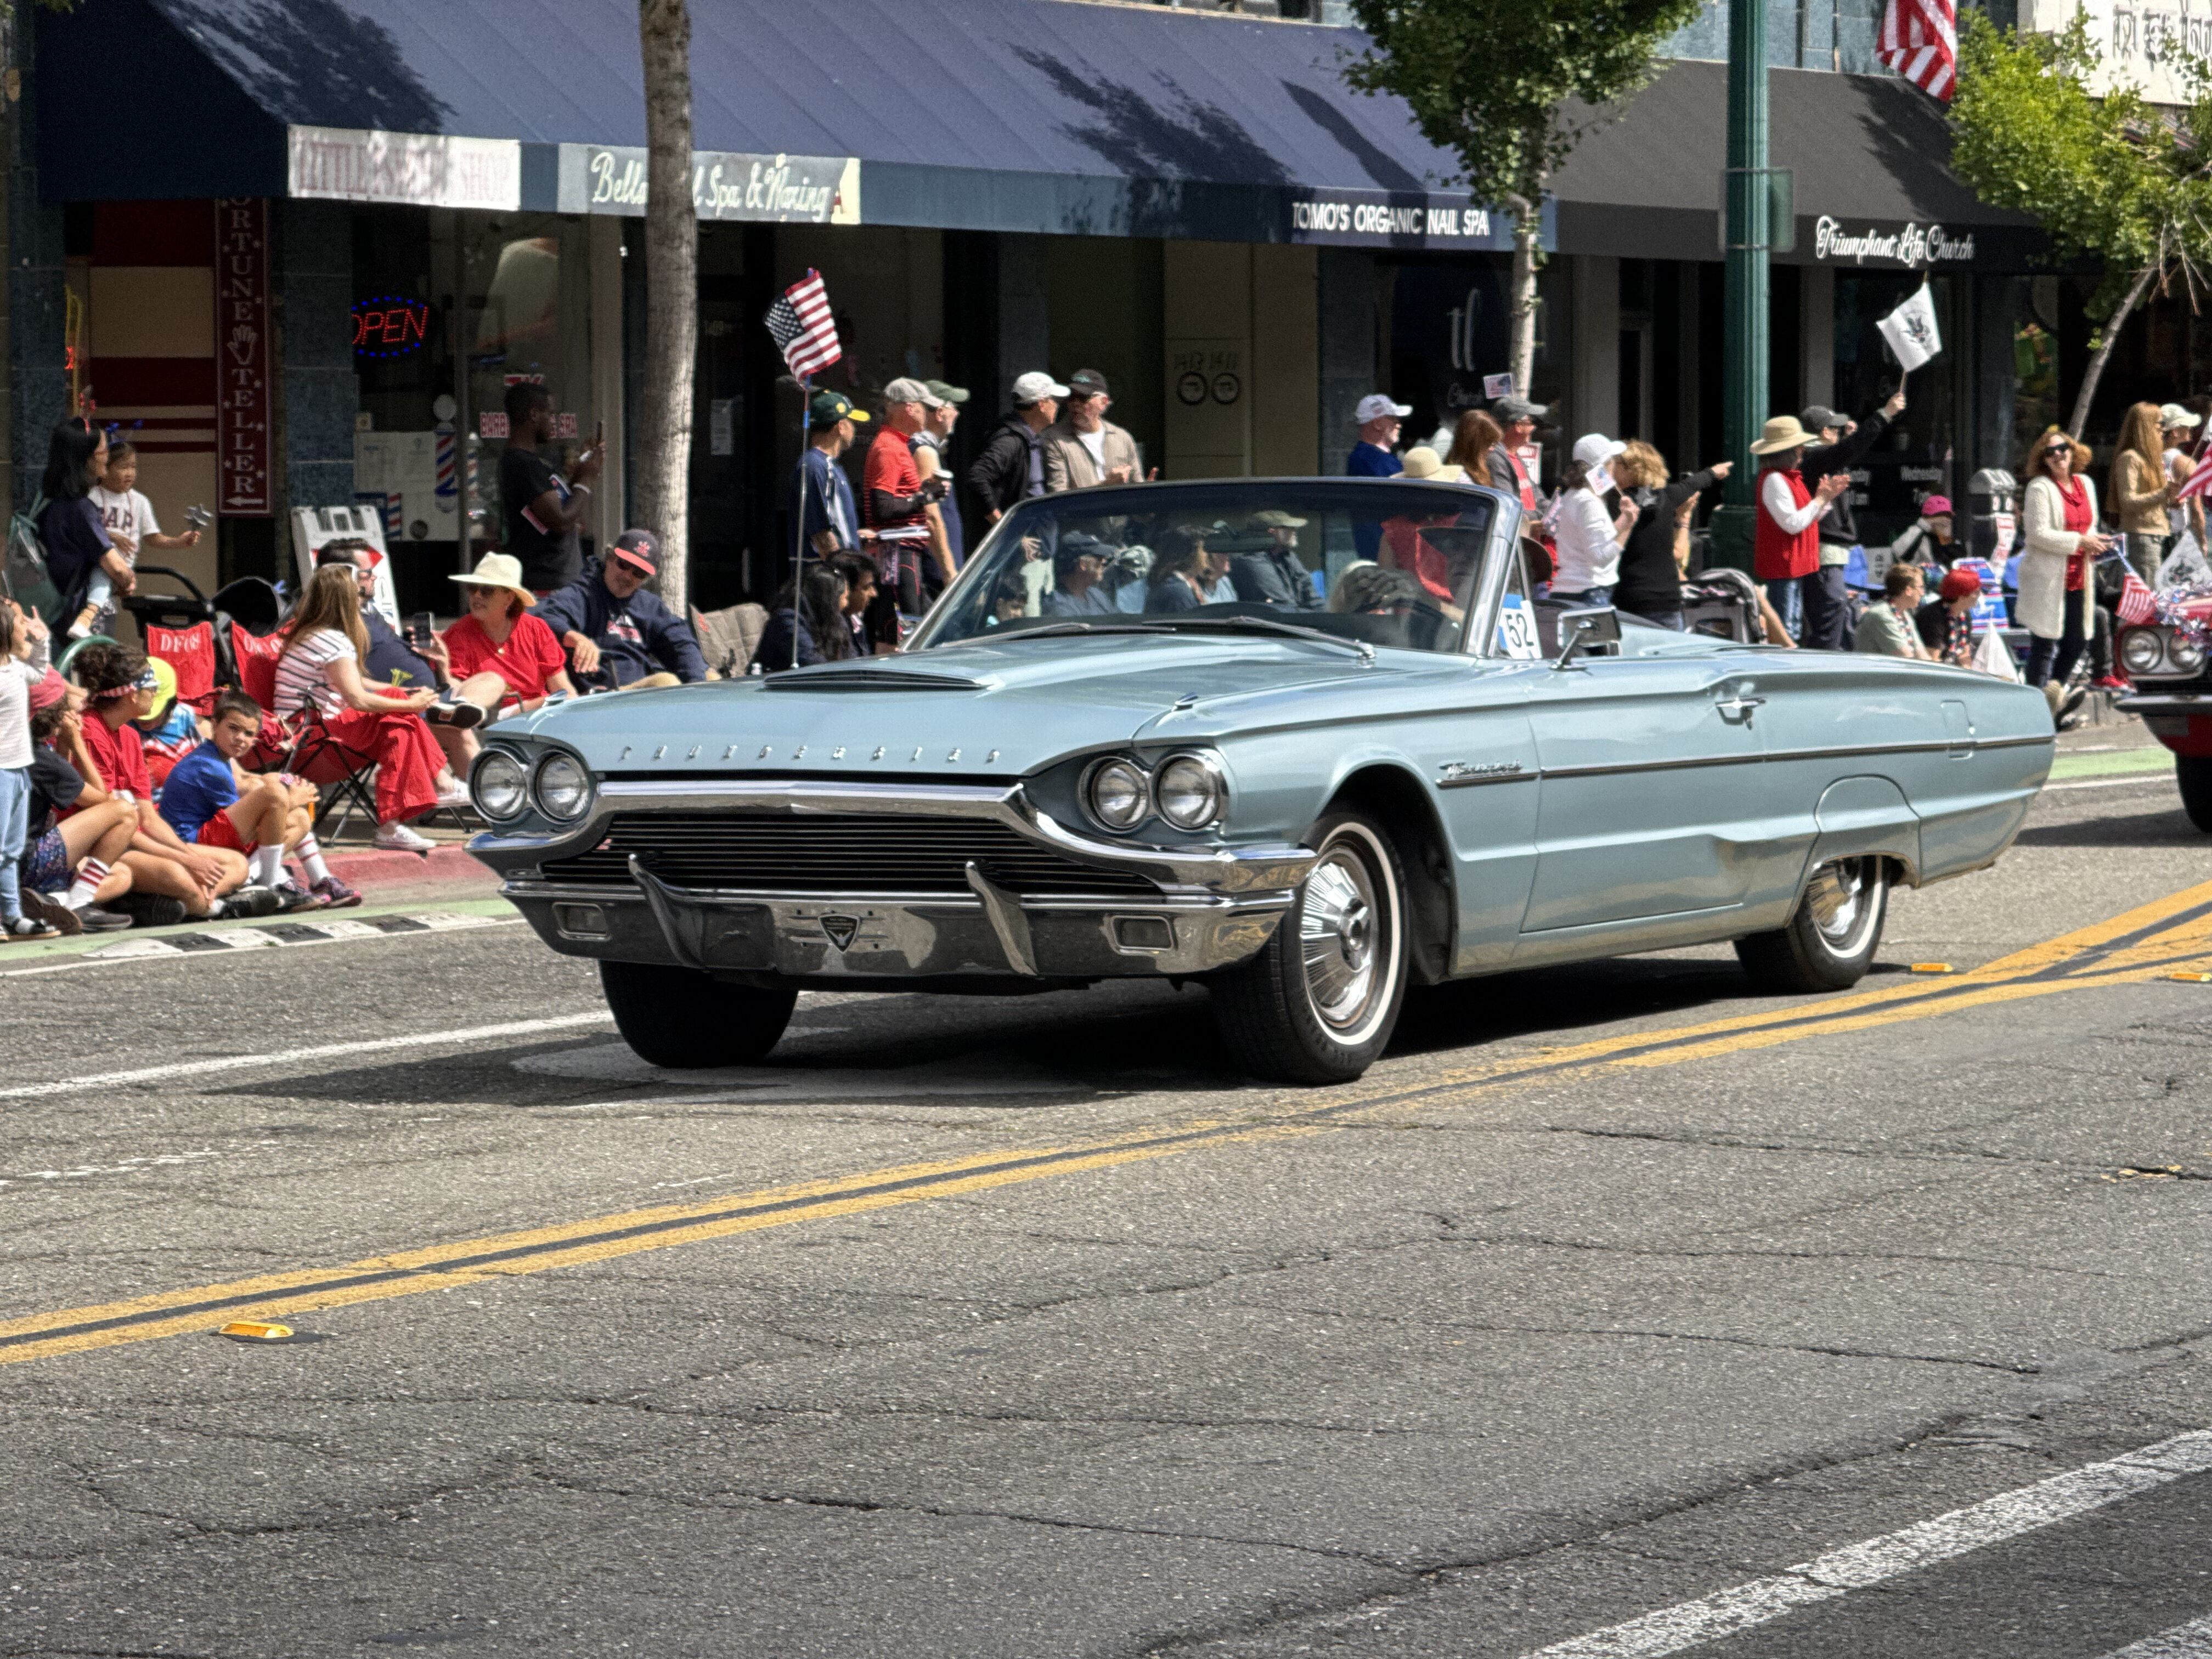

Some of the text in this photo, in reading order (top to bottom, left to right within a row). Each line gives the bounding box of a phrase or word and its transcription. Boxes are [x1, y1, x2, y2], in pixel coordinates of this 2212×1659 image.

[706, 165, 742, 217] Spa
[746, 162, 764, 208] &
[1292, 202, 1491, 236] TOMO'S ORGANIC NAIL SPA
[1816, 215, 1974, 268] Triumphant Life Church
[231, 368, 255, 493] TELLER
[1504, 613, 1534, 648] 52
